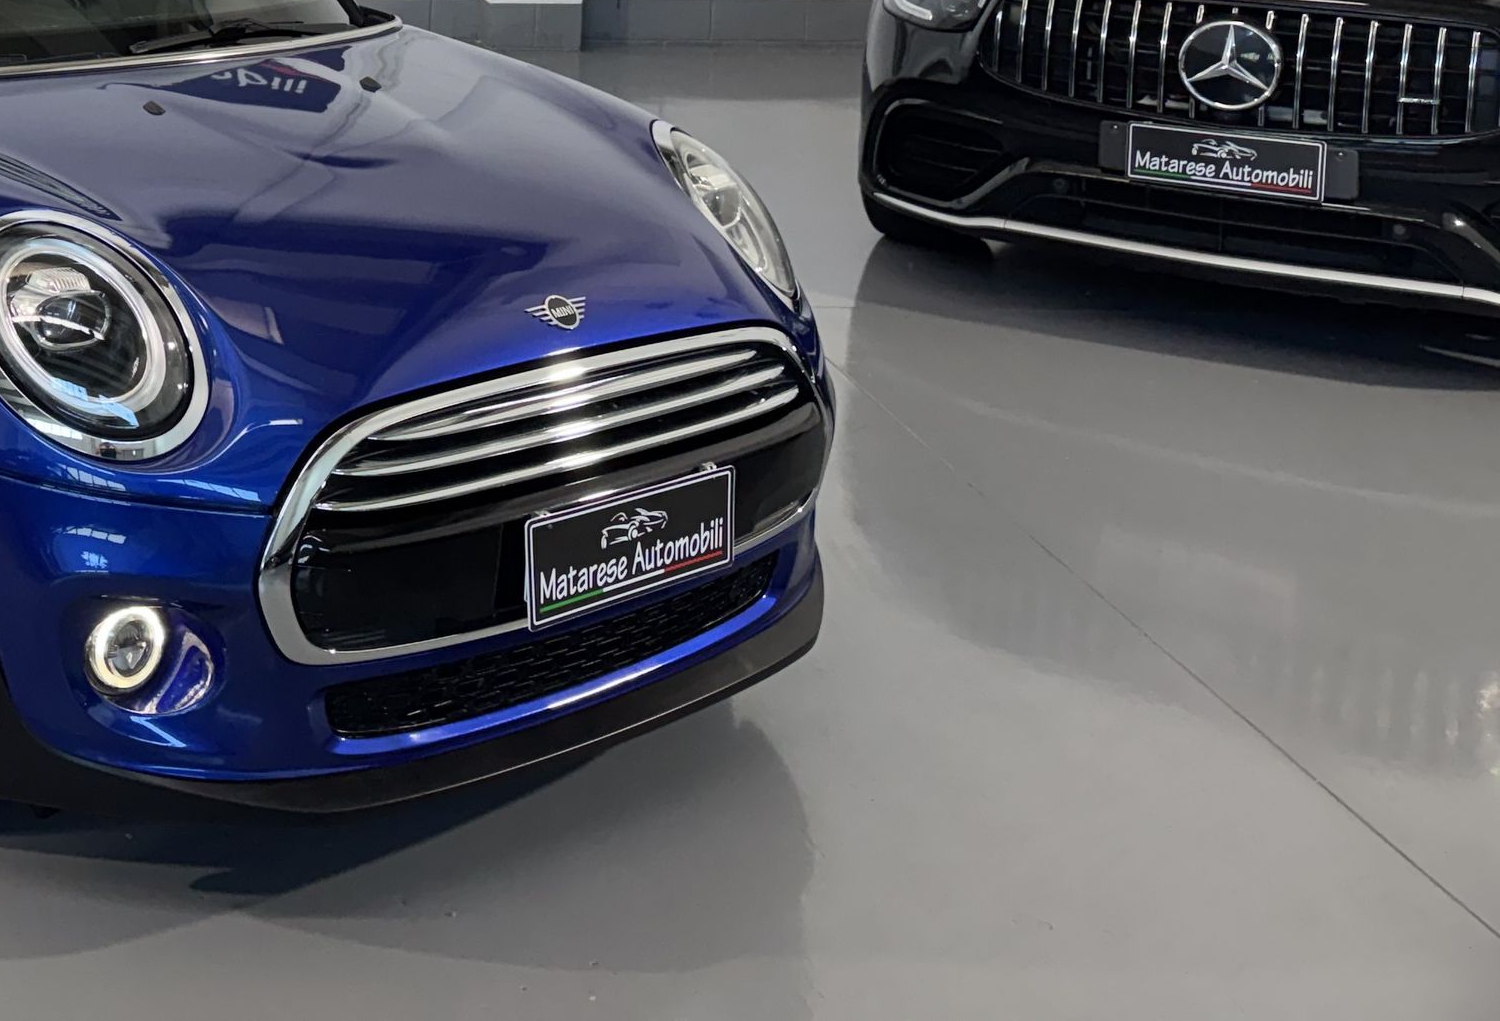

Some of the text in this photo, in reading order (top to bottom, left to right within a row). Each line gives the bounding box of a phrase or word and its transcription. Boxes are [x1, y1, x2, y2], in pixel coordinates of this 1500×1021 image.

[1135, 151, 1313, 189] Matarese Automobili
[550, 305, 575, 318] MINI
[540, 517, 723, 604] Matarese Automobili
